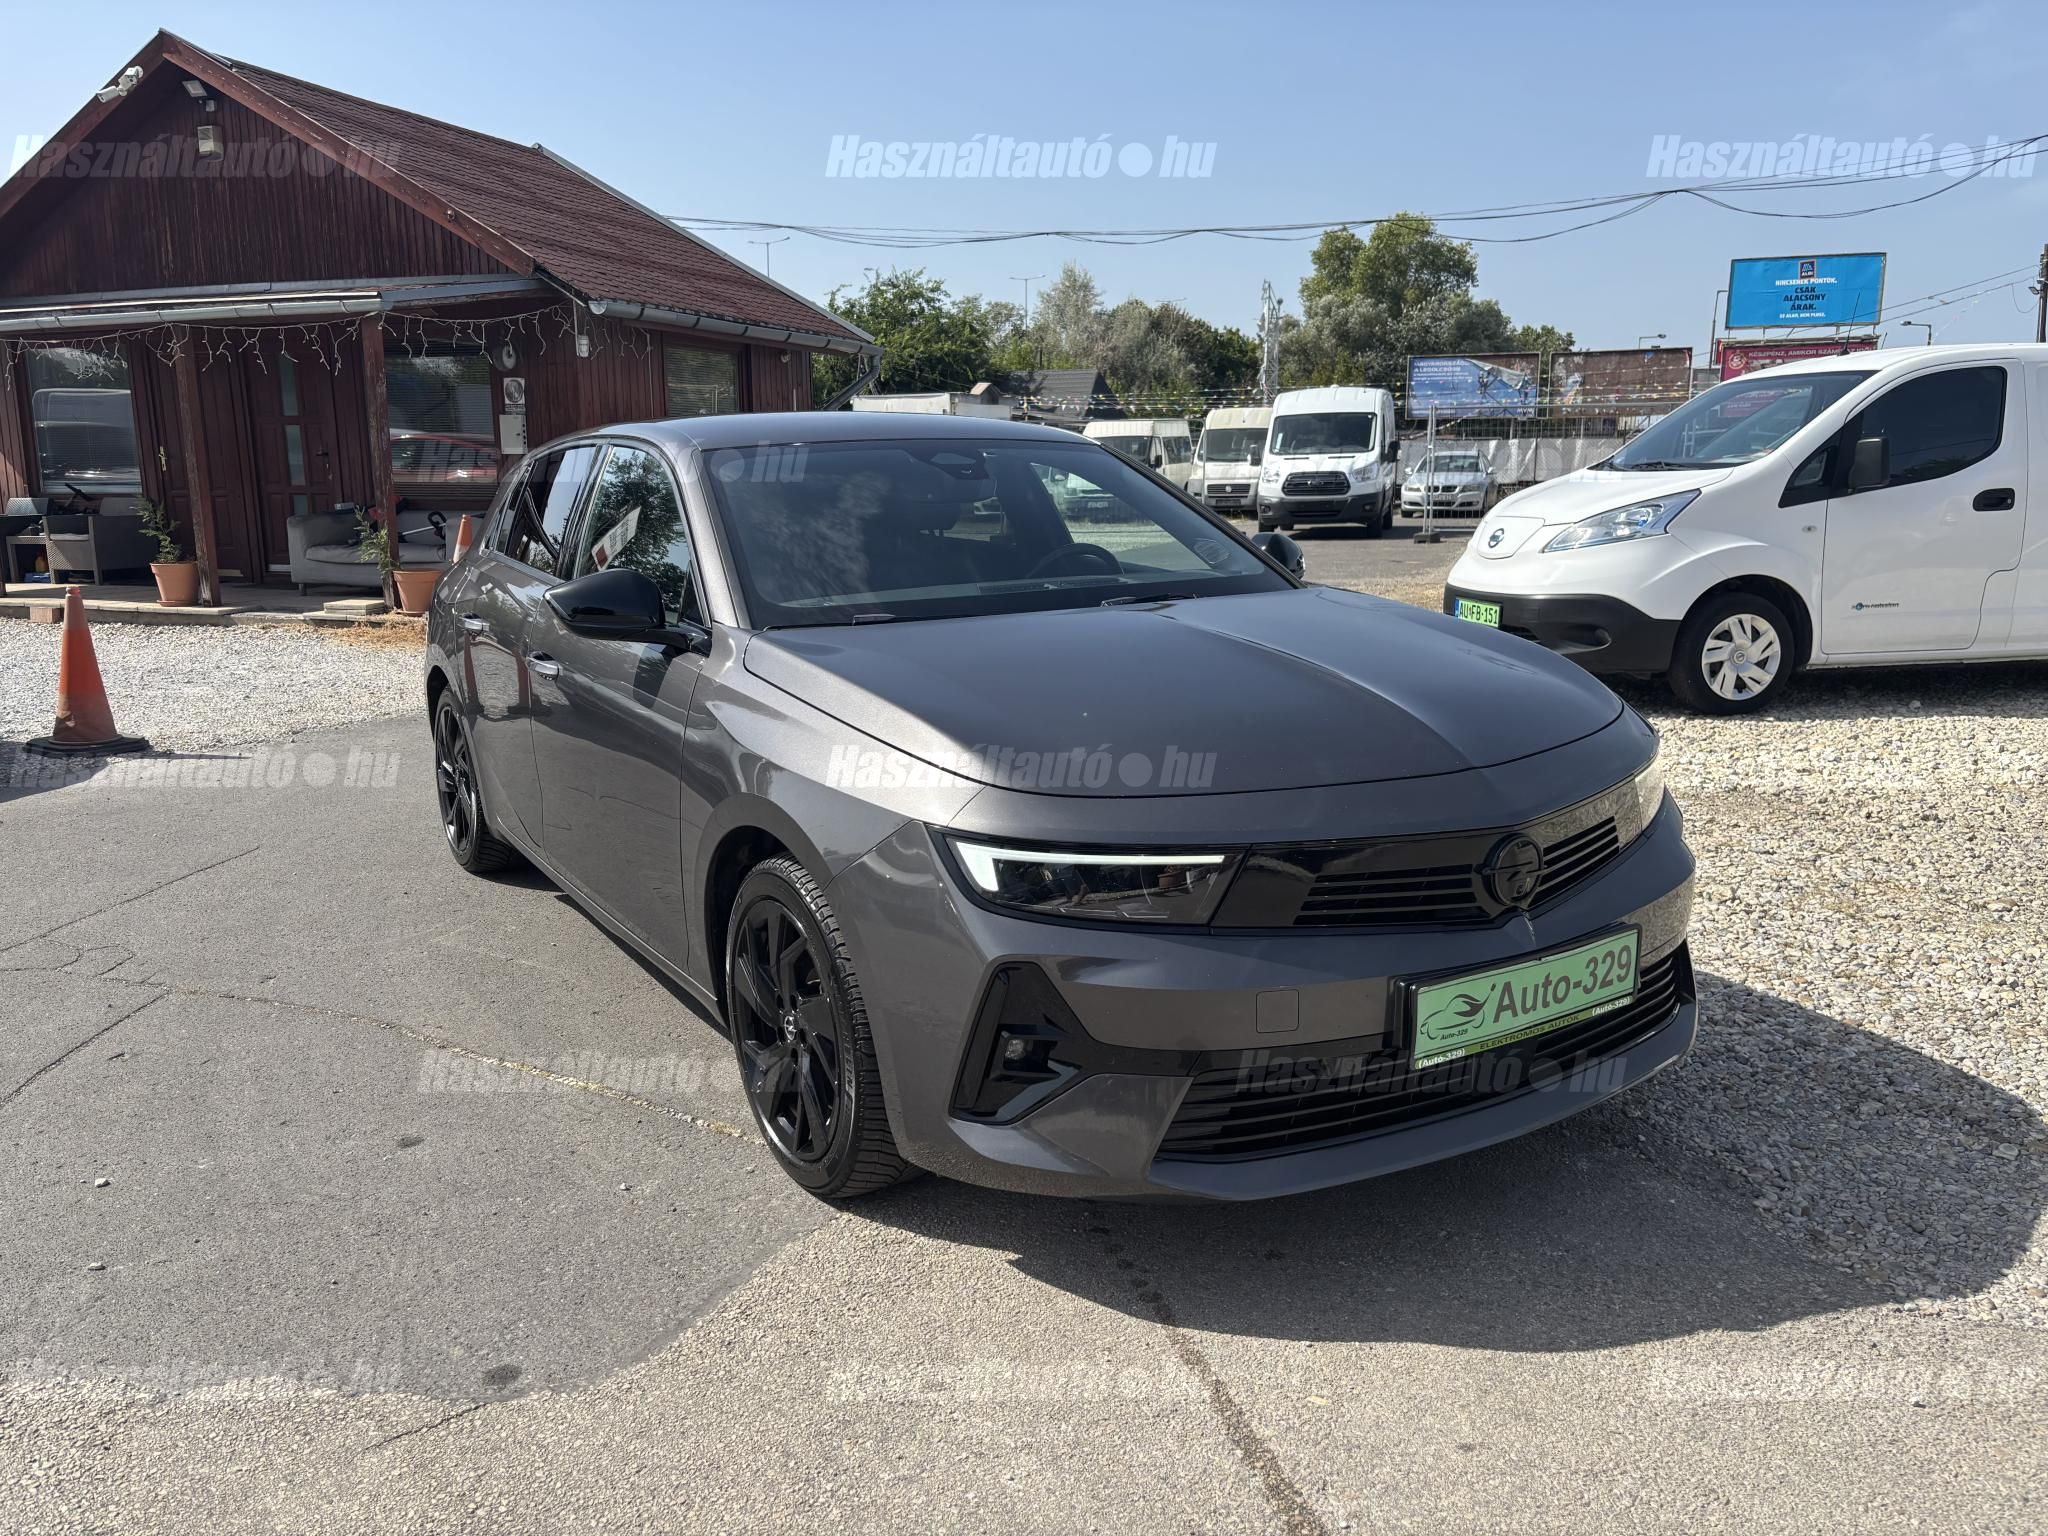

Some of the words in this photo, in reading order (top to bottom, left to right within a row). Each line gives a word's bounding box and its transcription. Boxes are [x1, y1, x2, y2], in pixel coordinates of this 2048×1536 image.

[1794, 286, 1817, 294] CSAK
[1783, 293, 1826, 302] ALACSONY
[1790, 302, 1817, 311] ÁRAK.
[1493, 944, 1632, 1024] Auto-329
[1479, 1025, 1546, 1050] ELEKTROMOS
